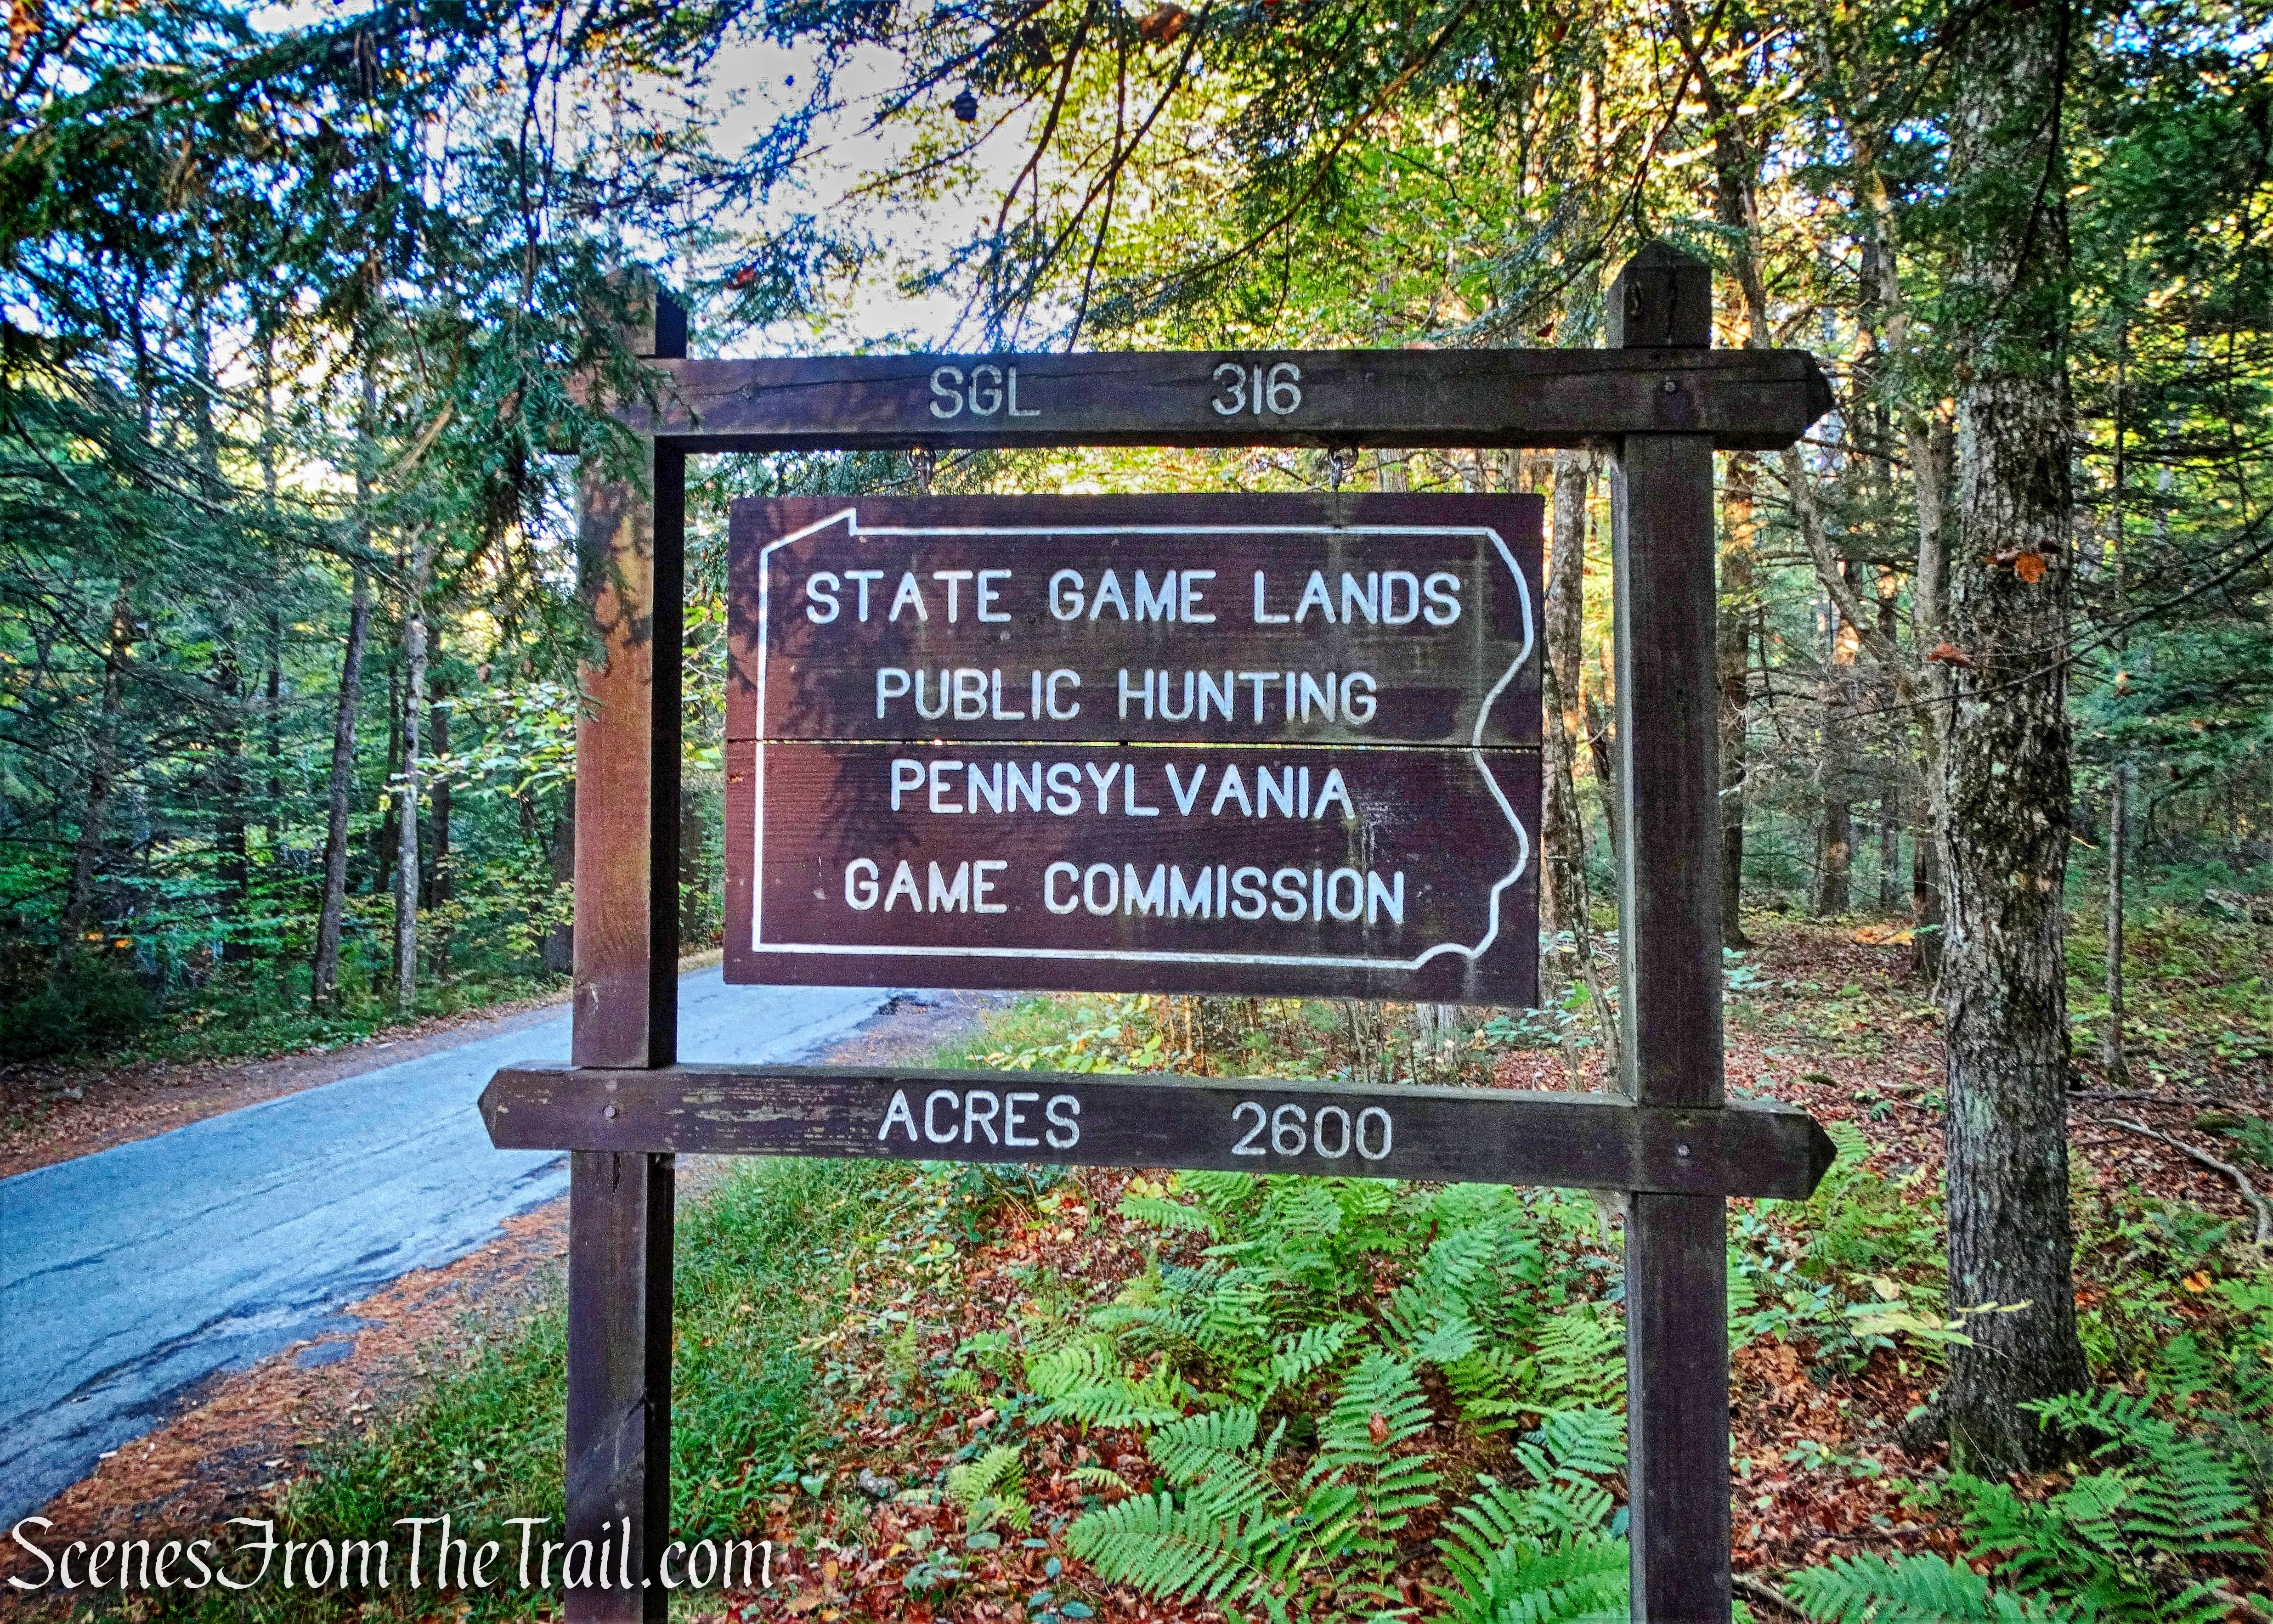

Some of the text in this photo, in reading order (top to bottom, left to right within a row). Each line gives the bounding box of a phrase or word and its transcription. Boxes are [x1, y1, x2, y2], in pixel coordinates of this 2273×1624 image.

[929, 362, 1303, 419] SGL 316
[805, 569, 1462, 626] STATE GAME LANDS
[876, 668, 1377, 726] PUBLIC HUNTING
[890, 759, 1356, 820] PENNSYLVANIA
[844, 858, 1404, 925] GAME COMMISSION
[876, 1090, 1393, 1161] ACRES 2600
